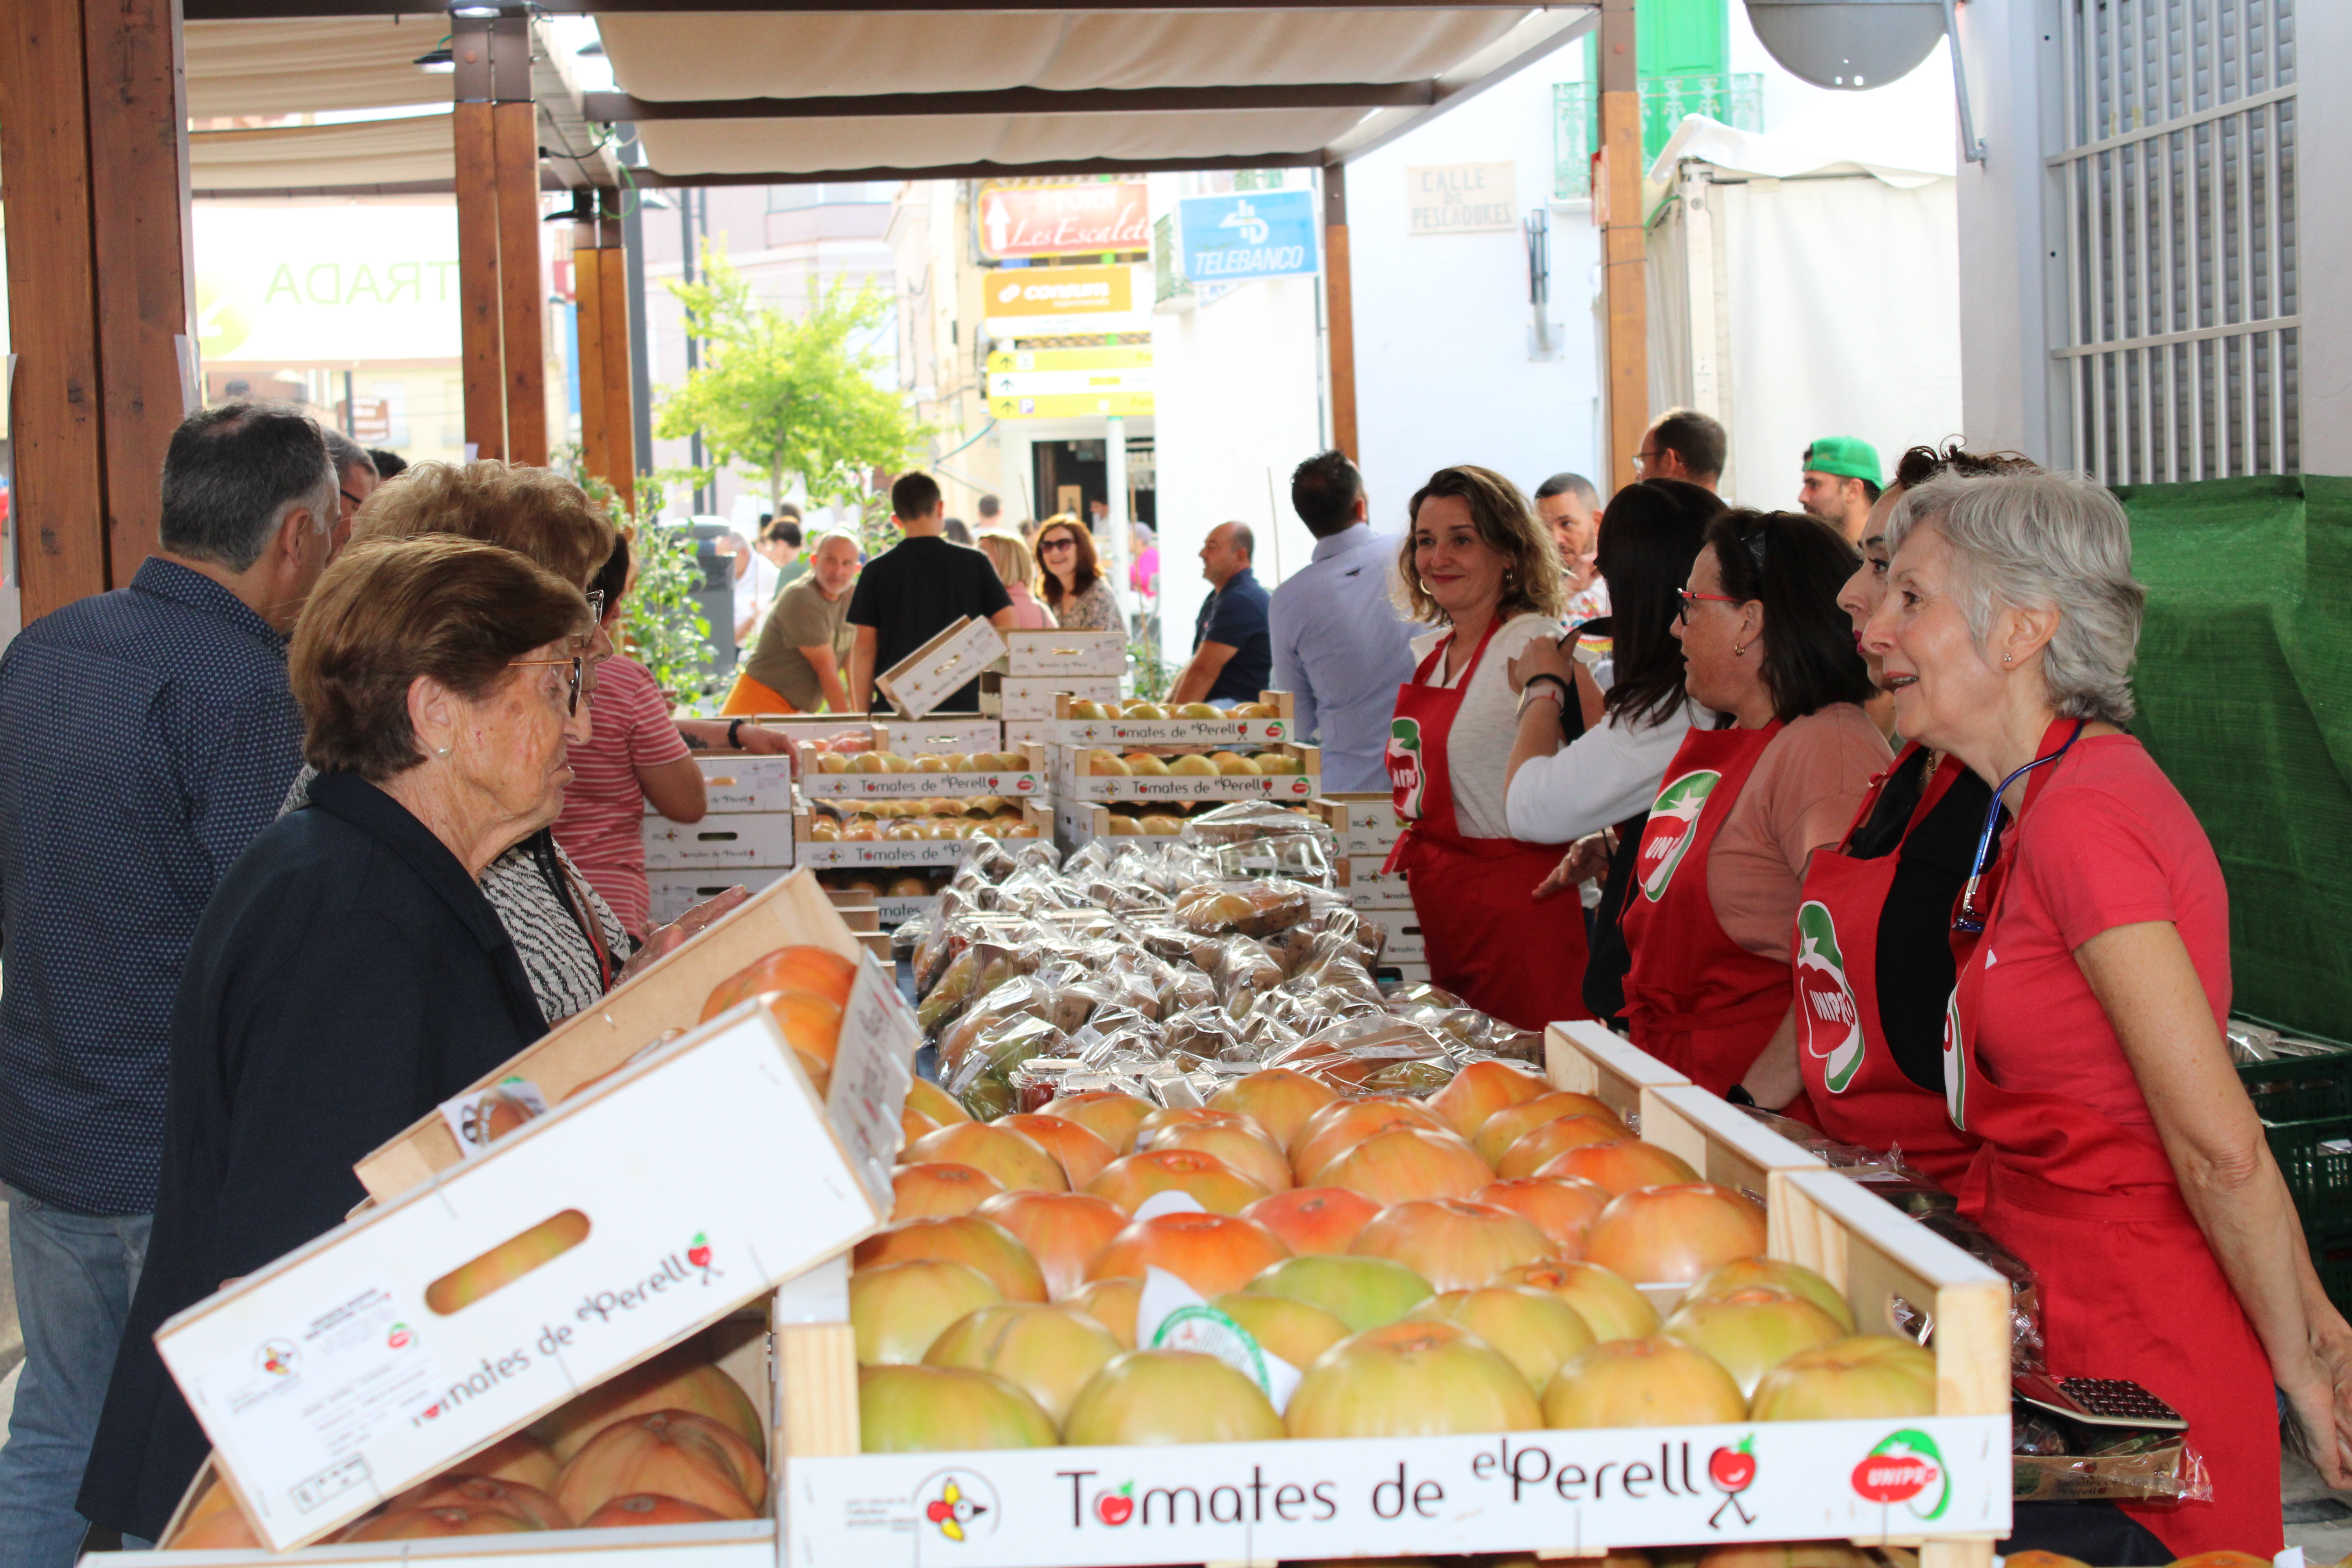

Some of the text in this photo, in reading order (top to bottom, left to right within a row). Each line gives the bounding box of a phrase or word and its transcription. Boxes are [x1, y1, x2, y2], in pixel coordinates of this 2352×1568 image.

[1422, 168, 1487, 192] CALLE
[1055, 187, 1118, 211] FORN
[1443, 192, 1463, 204] DE
[1412, 202, 1512, 228] PESCADORES
[1194, 245, 1304, 275] TELEBANCO
[1024, 282, 1110, 299] consum
[1110, 726, 1165, 739] Tomates
[1171, 725, 1187, 738] de
[860, 779, 918, 793] Tomates
[921, 780, 937, 792] de
[1132, 780, 1188, 794] Tomates
[1194, 780, 1210, 793] de
[856, 847, 916, 861] Tomates
[922, 846, 939, 859] de
[879, 904, 921, 917] mates
[537, 1323, 574, 1356] de
[1055, 1464, 1338, 1528] Tomates
[1372, 1461, 1446, 1520] de
